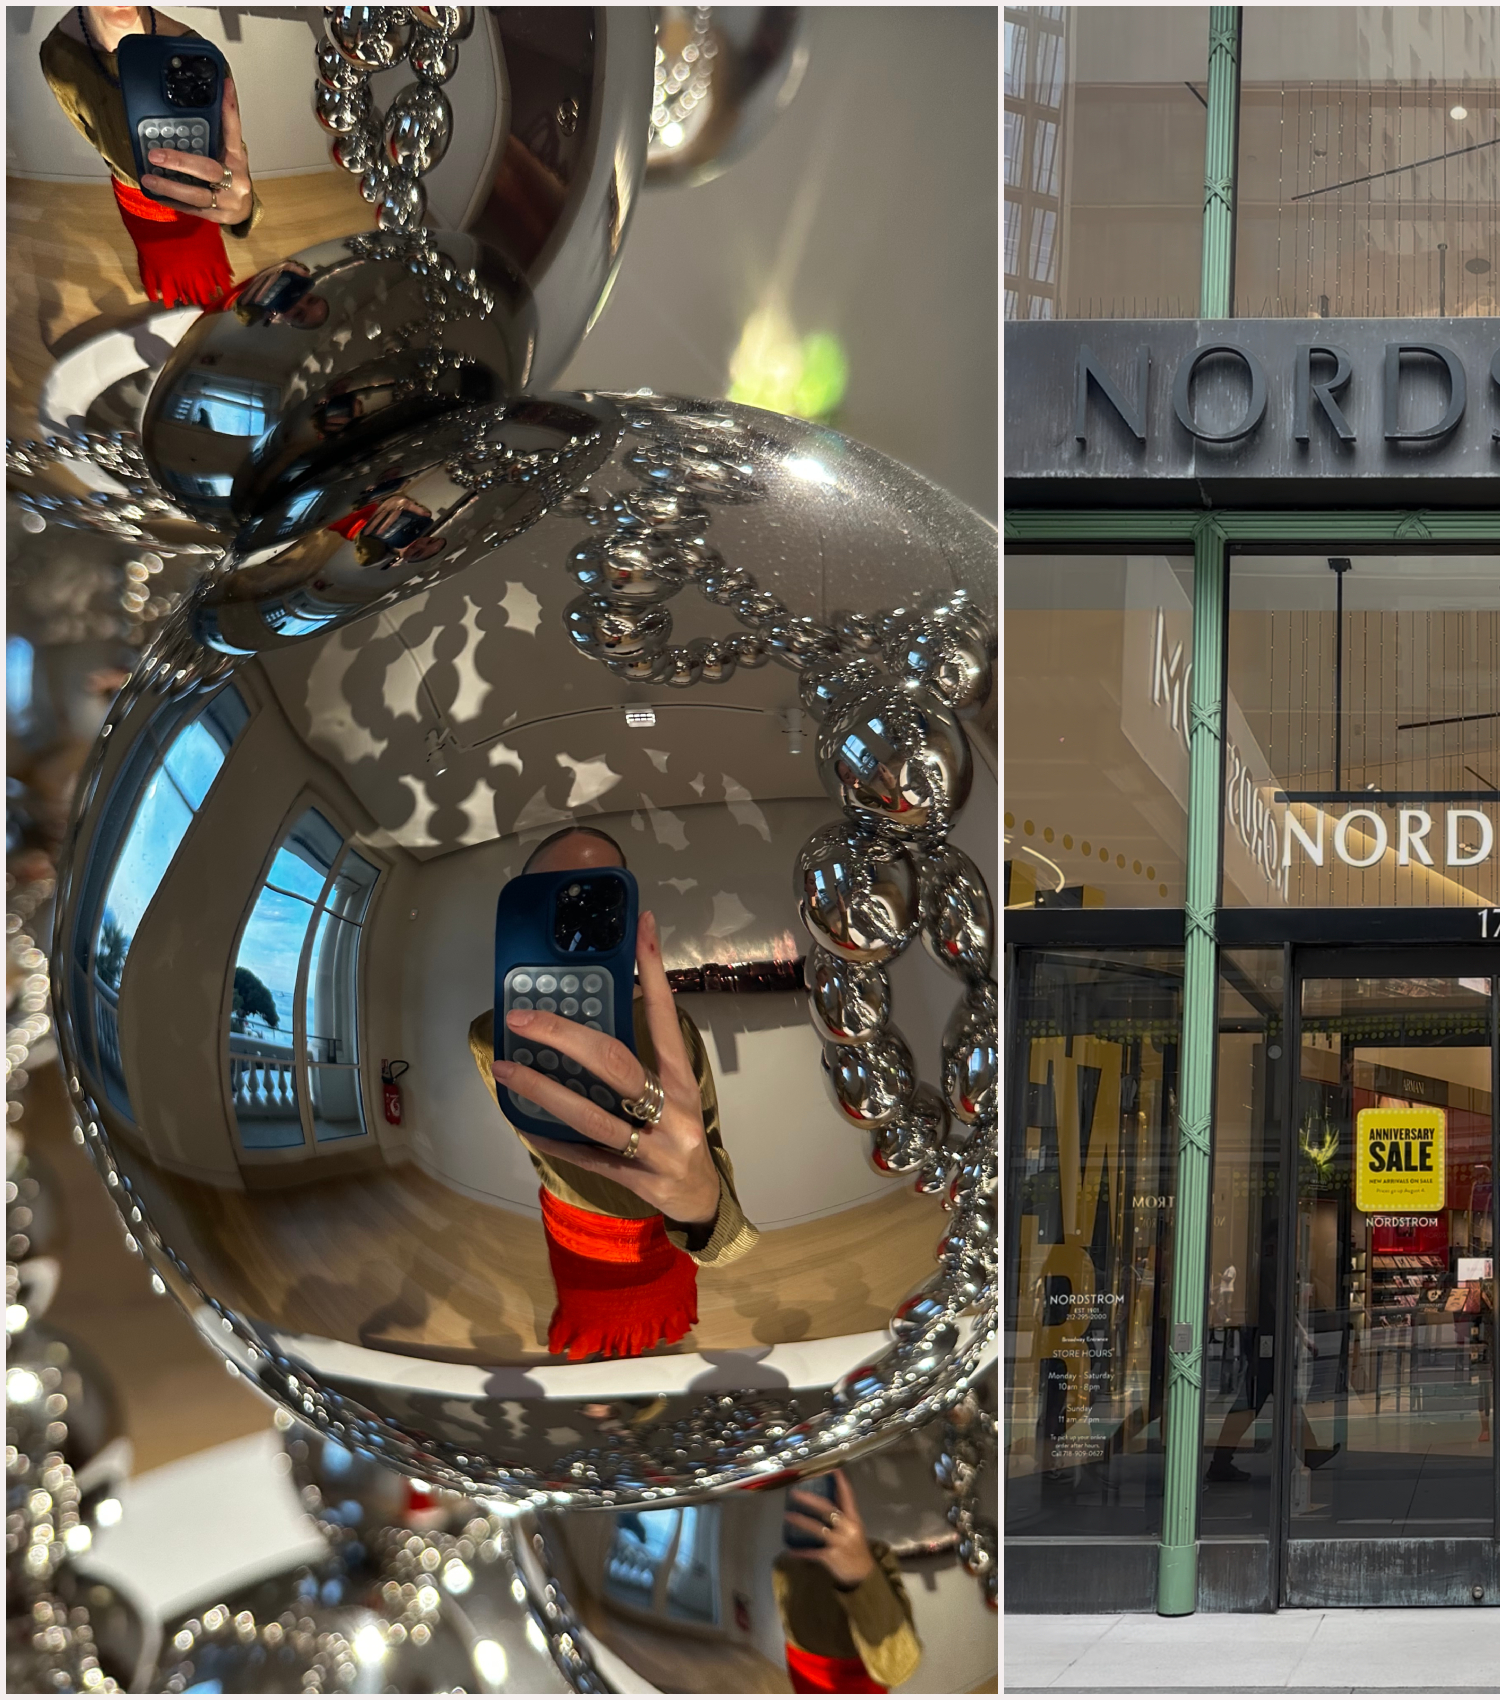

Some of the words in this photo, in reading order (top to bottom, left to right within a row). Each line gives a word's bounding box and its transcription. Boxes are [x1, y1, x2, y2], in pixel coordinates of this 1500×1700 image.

[1369, 1127, 1435, 1140] ANNIVERSARY
[1369, 1141, 1433, 1173] SALE
[1366, 1217, 1438, 1227] NORDSTROM
[1050, 1294, 1124, 1305] NORDSTROM
[1053, 1349, 1080, 1358] STORE
[1082, 1349, 1113, 1358] HOURS
[1048, 1371, 1077, 1381] Monday
[1084, 1371, 1115, 1381] Saturday
[1058, 1382, 1078, 1390] 10am
[1083, 1382, 1100, 1392] 8pm
[1066, 1404, 1093, 1415] Sunday
[1083, 1415, 1100, 1425] 7pm
